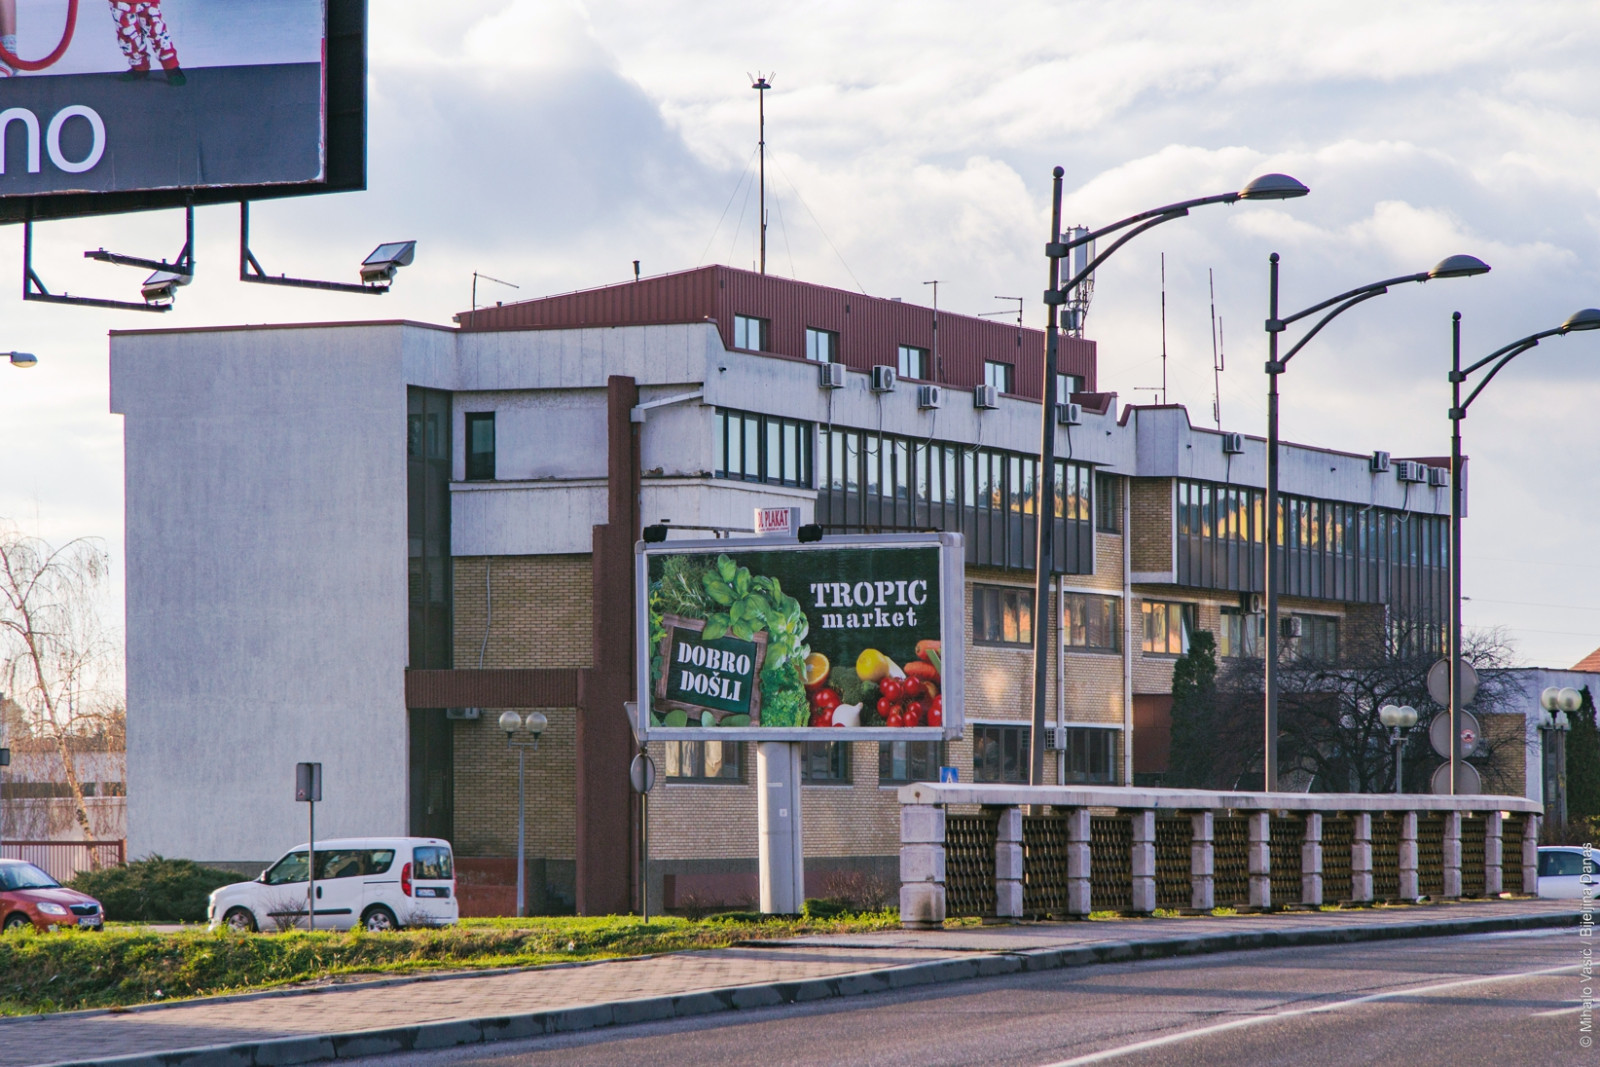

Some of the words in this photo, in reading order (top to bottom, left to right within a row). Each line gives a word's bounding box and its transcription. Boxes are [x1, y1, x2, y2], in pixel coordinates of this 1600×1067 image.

[764, 509, 788, 527] PLAKAT
[810, 579, 927, 607] TROPIC
[822, 607, 917, 628] market
[677, 642, 751, 675] DOBRO
[680, 670, 742, 701] DOŠLI
